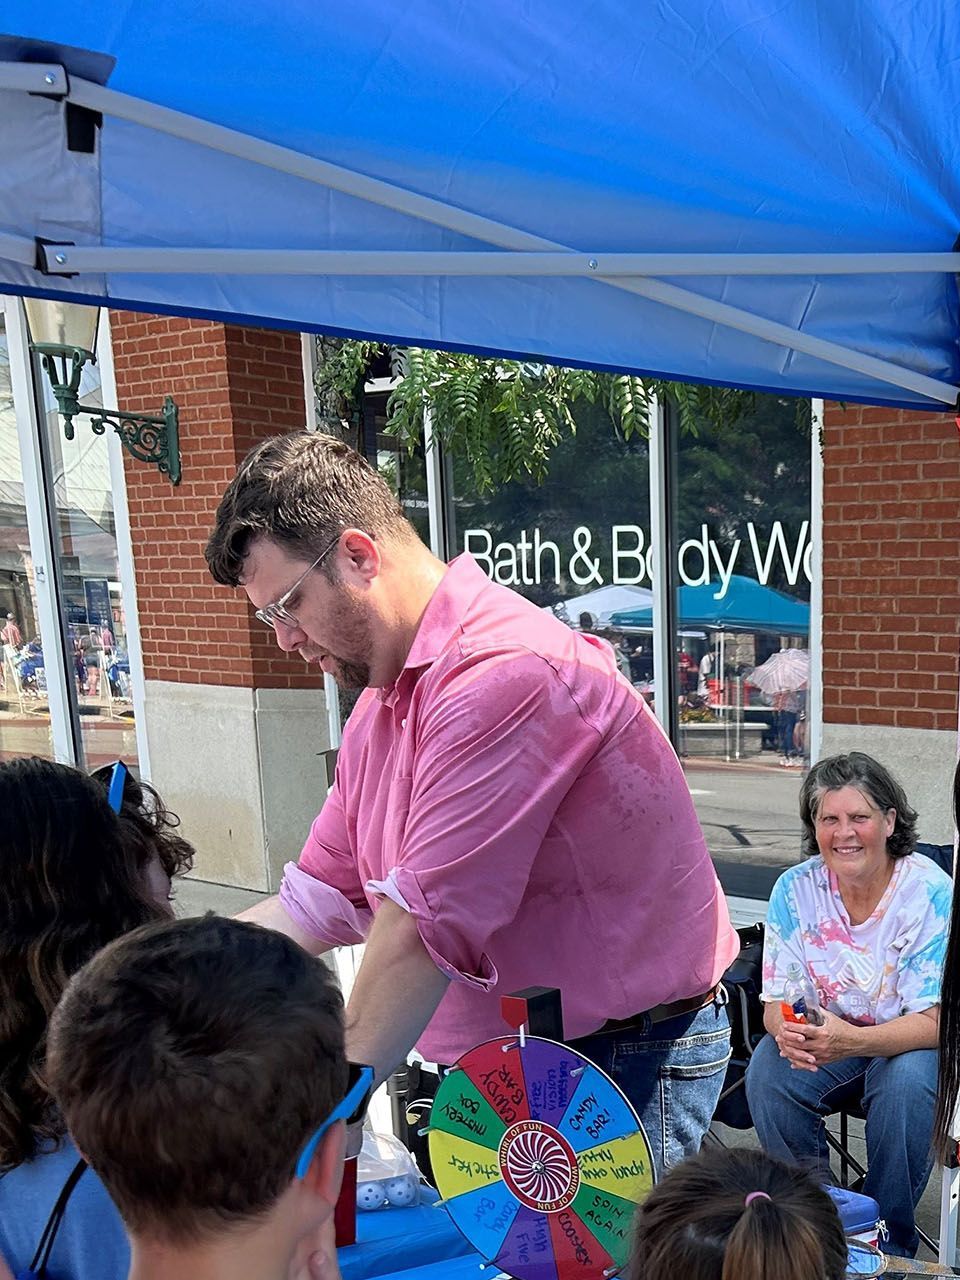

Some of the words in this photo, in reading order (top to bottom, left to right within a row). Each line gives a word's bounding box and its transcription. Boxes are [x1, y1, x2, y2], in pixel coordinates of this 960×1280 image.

[464, 527, 561, 586] Bath
[569, 526, 603, 586] &
[612, 521, 739, 600] Bdy
[501, 1137, 512, 1167] WHIRL
[511, 1127, 521, 1137] OF
[523, 1123, 542, 1131] FUN
[567, 1166, 580, 1195] WHIRL
[538, 1202, 556, 1210] FUN
[558, 1197, 568, 1207] OF
[592, 1194, 624, 1219] SPIN
